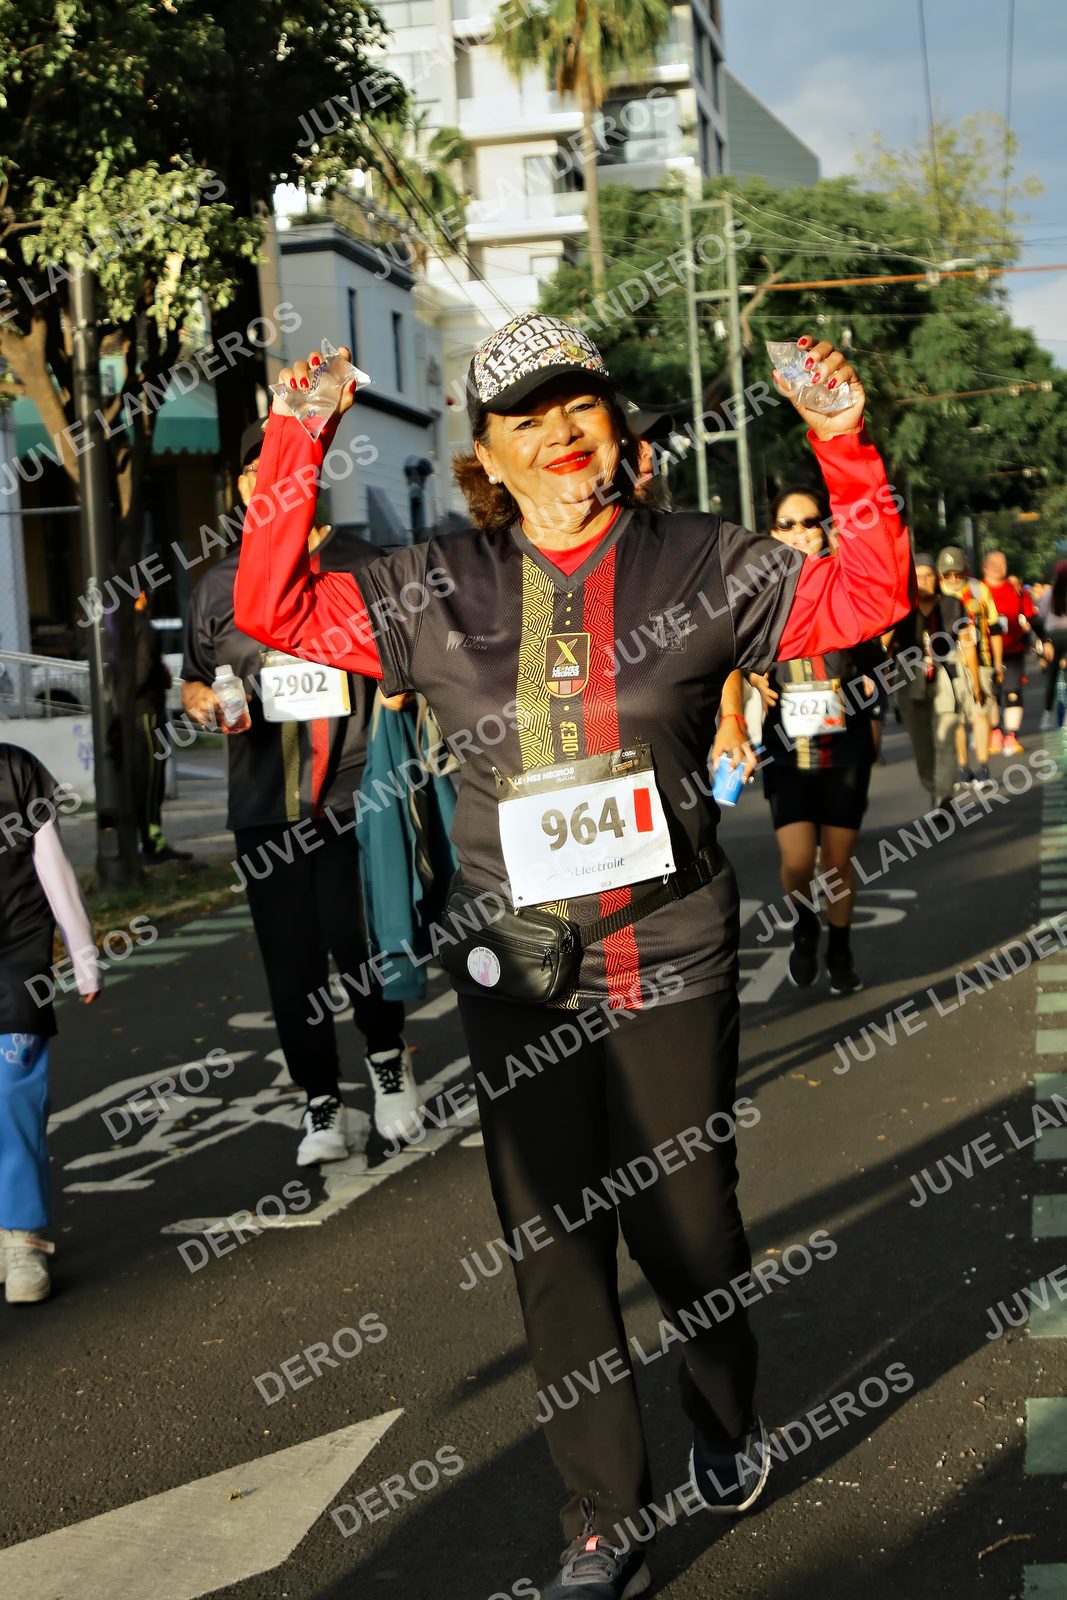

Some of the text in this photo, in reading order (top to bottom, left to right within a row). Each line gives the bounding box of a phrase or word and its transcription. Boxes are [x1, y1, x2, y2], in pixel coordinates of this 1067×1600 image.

[494, 329, 592, 379] NEGROS
[272, 670, 328, 697] 2902
[789, 700, 830, 716] 2621
[543, 767, 575, 780] NEGROS
[540, 796, 626, 851] 964
[575, 857, 626, 877] Electrolit
